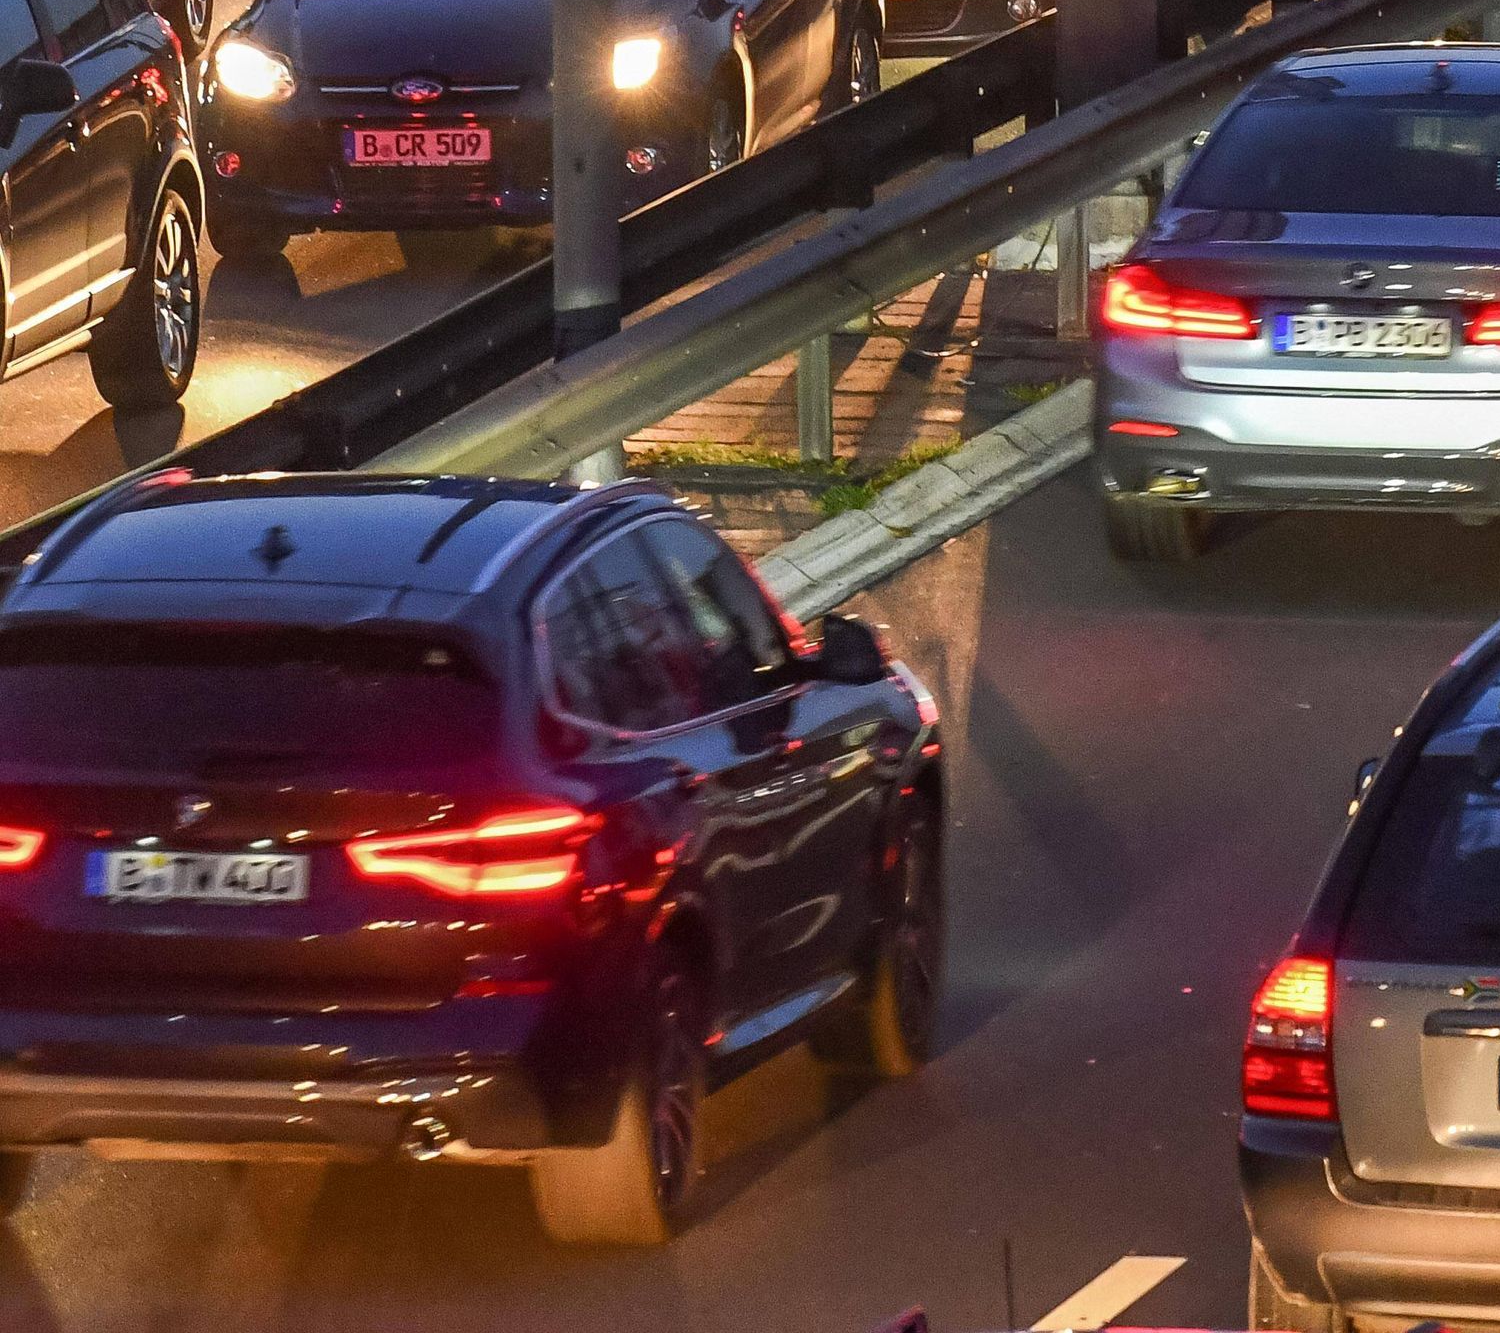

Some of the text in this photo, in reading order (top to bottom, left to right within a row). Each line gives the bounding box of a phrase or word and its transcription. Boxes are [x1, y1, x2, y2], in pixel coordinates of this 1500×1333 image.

[361, 133, 481, 158] B CR 509
